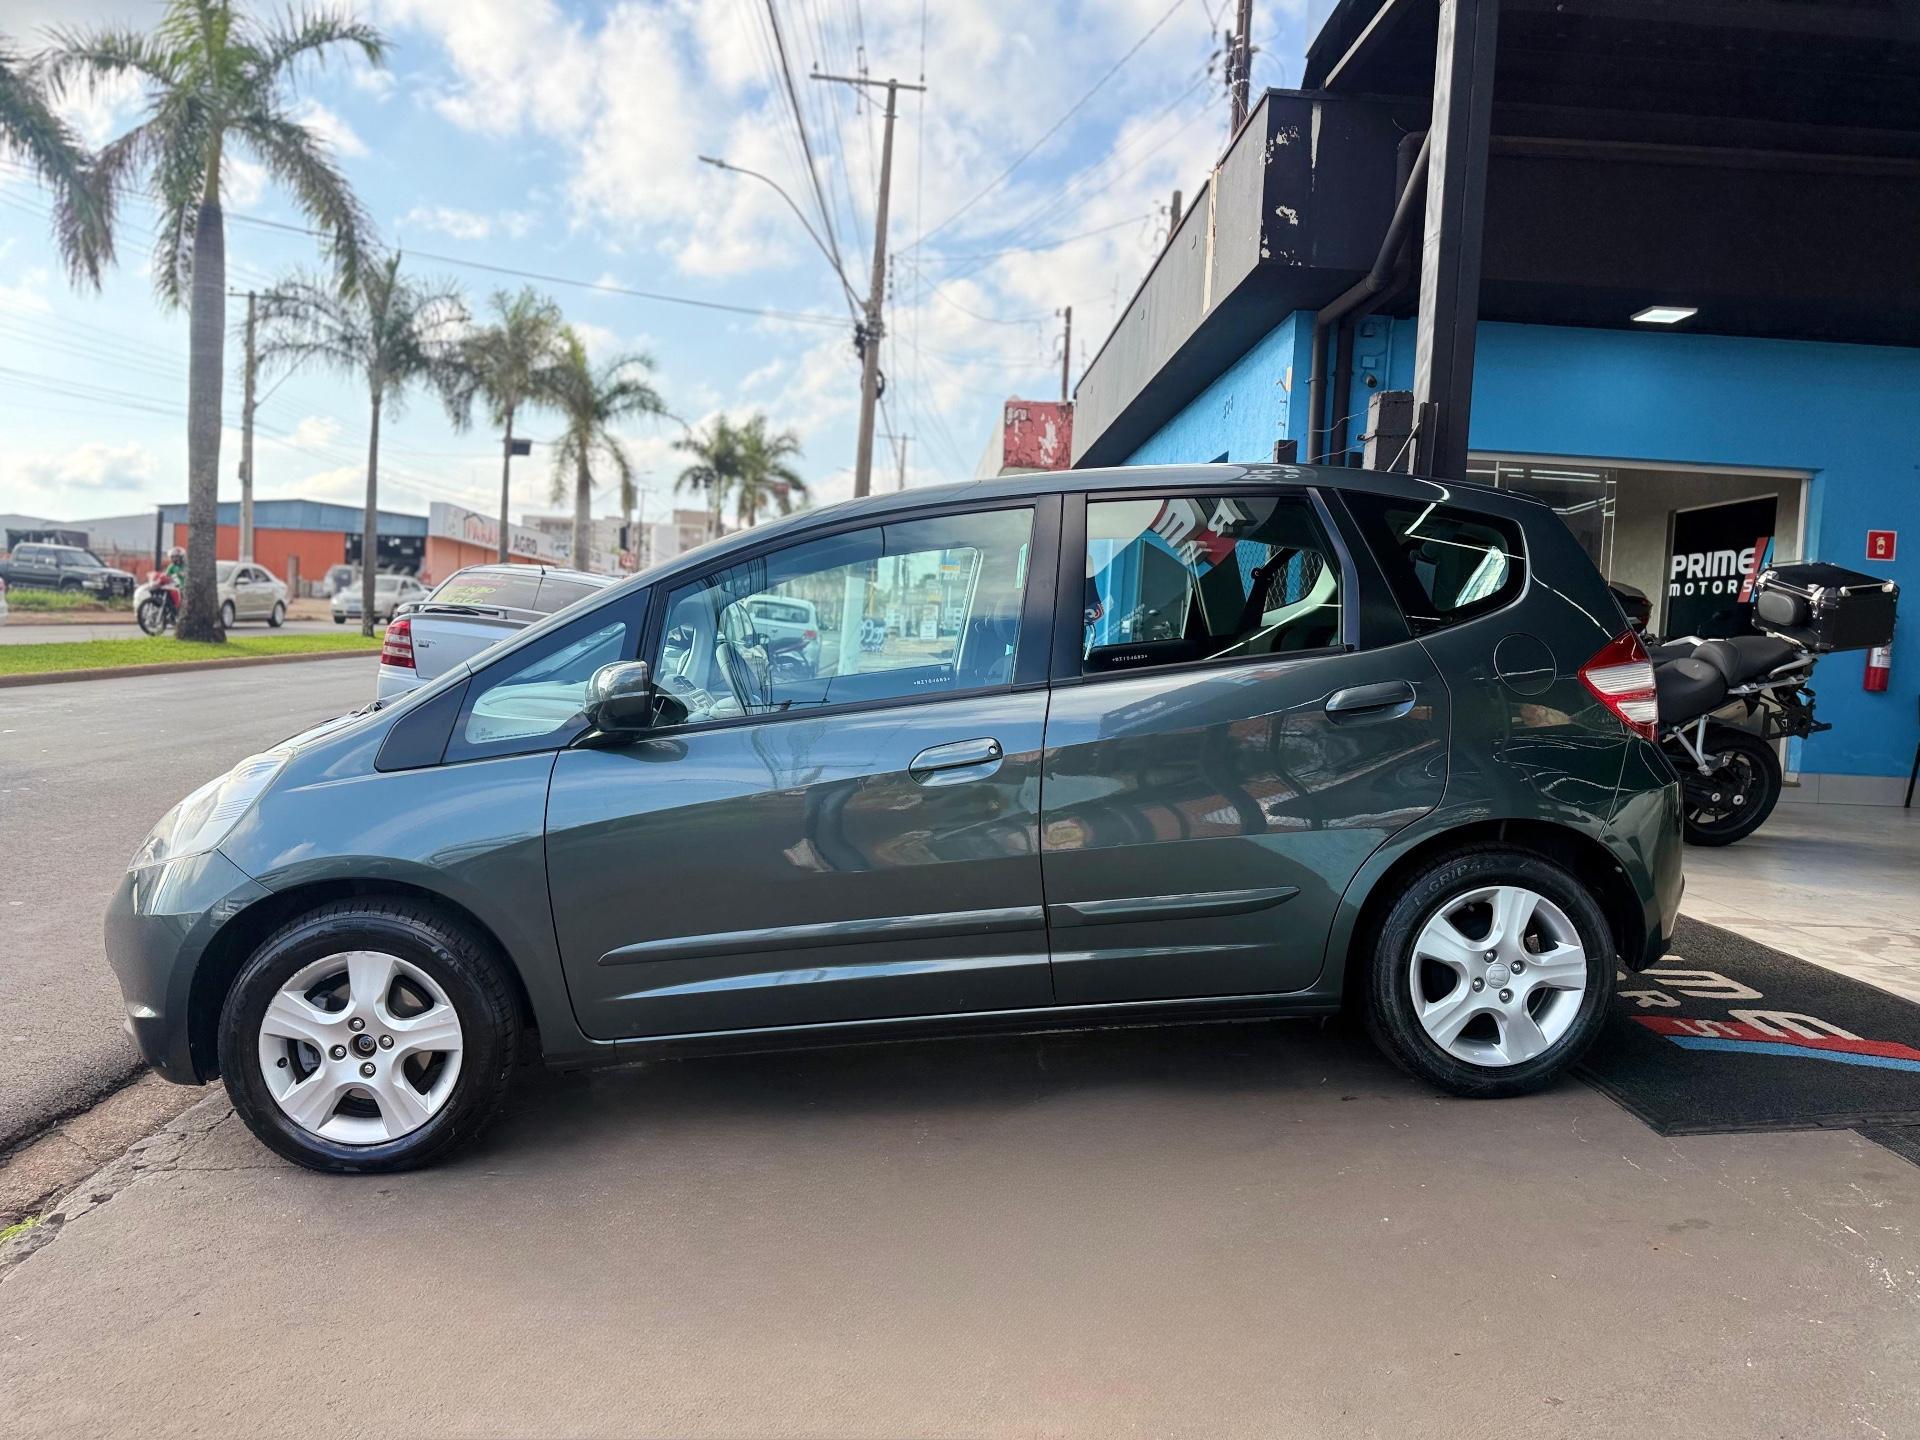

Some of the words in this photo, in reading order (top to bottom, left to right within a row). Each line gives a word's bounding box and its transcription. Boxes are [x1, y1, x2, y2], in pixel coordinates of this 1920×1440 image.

[513, 533, 537, 555] AGRO
[1670, 547, 1755, 579] PRIME
[1669, 579, 1754, 597] MOTORS
